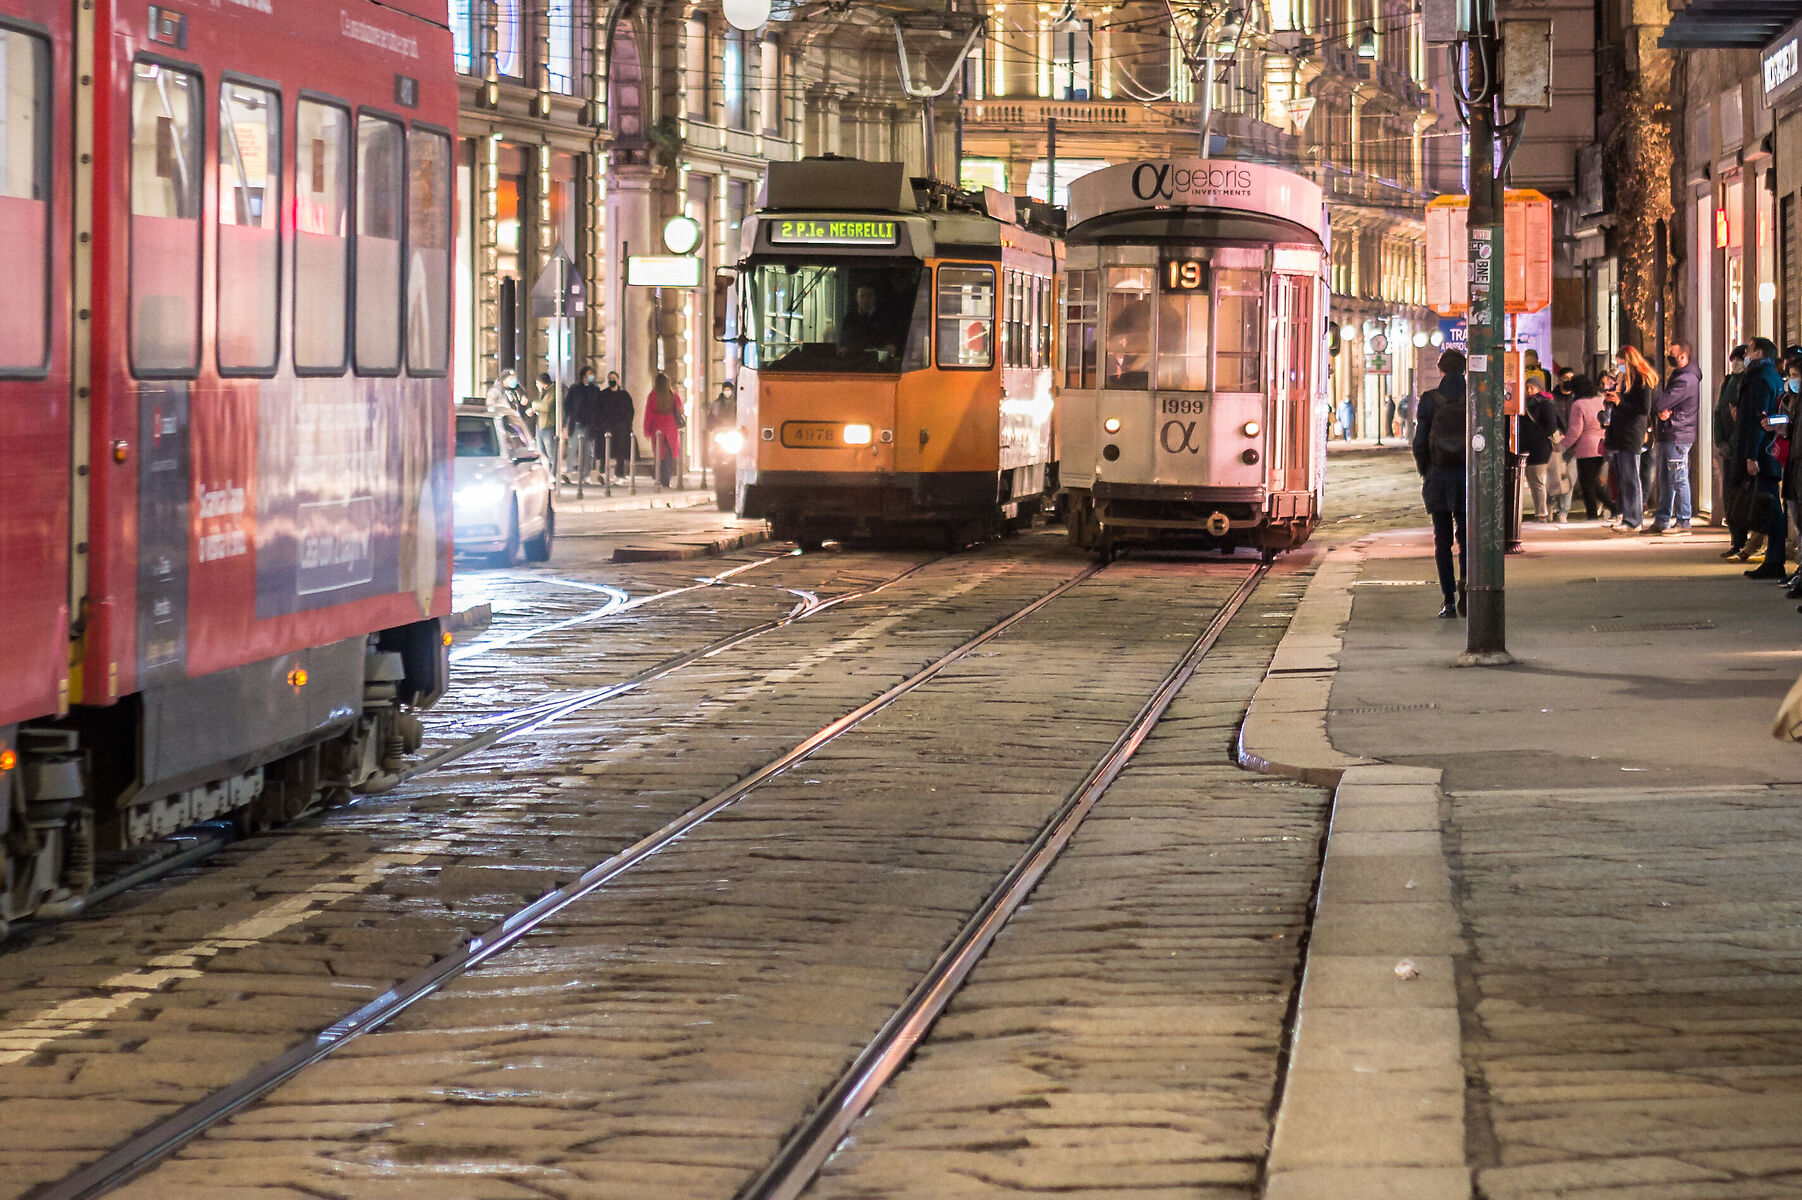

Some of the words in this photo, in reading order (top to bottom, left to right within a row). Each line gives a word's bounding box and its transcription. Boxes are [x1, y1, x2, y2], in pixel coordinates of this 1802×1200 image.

[781, 222, 793, 238] 2
[829, 223, 893, 238] NEGRELLI
[1169, 261, 1200, 288] 19
[1477, 261, 1489, 282] BNE
[1162, 399, 1203, 414] 1999
[794, 429, 834, 441] 4978
